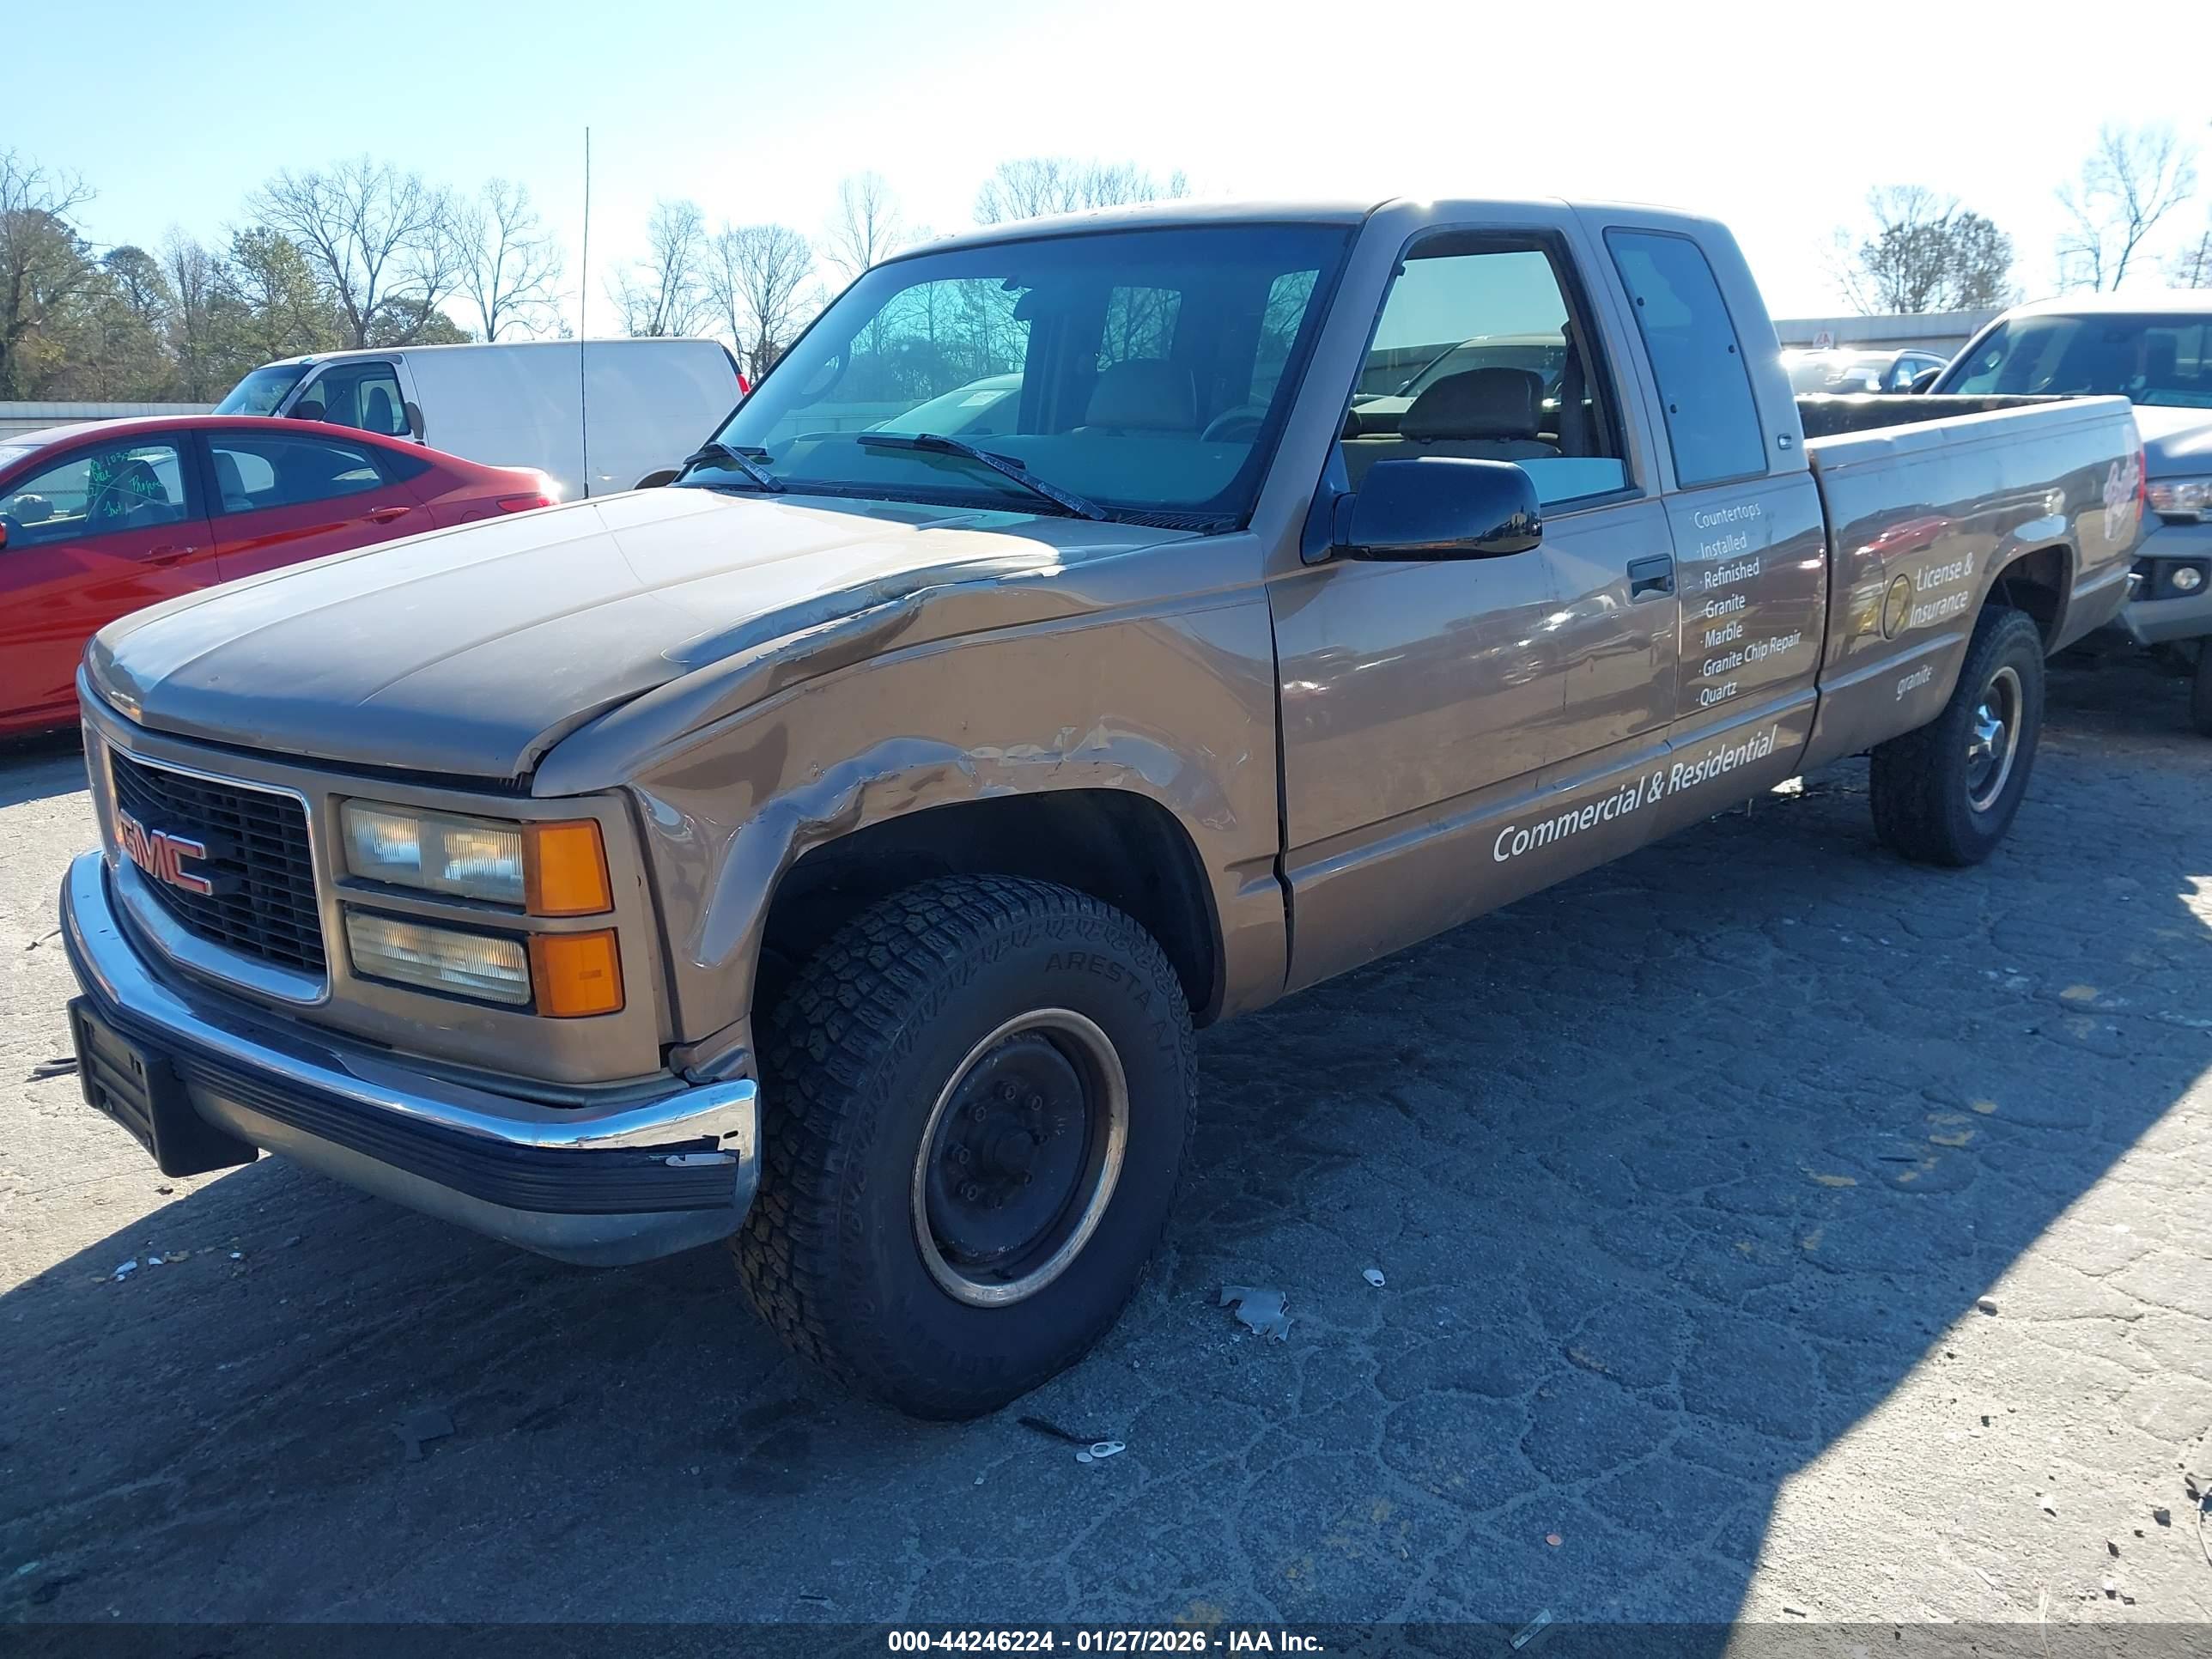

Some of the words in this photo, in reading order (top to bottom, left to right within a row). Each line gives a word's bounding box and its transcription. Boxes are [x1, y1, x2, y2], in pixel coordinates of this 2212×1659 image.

[1694, 502, 1761, 529] Countertops
[1700, 531, 1747, 559] Installed
[1705, 557, 1759, 590] Refinished
[1916, 560, 1963, 592] License
[1964, 552, 1974, 576] &
[1705, 593, 1746, 618] Granite
[1909, 591, 1969, 628] Insurance
[1705, 622, 1743, 648] Marble
[1703, 652, 1743, 677] Granite
[1744, 641, 1768, 662] Chip
[1770, 629, 1802, 653] Repair
[1700, 681, 1738, 707] Quartz
[1492, 776, 1645, 863] Commercial
[1646, 770, 1666, 804] &
[1667, 723, 1778, 796] Residential
[118, 807, 213, 896] GMC
[1044, 951, 1152, 1012] ARESTA
